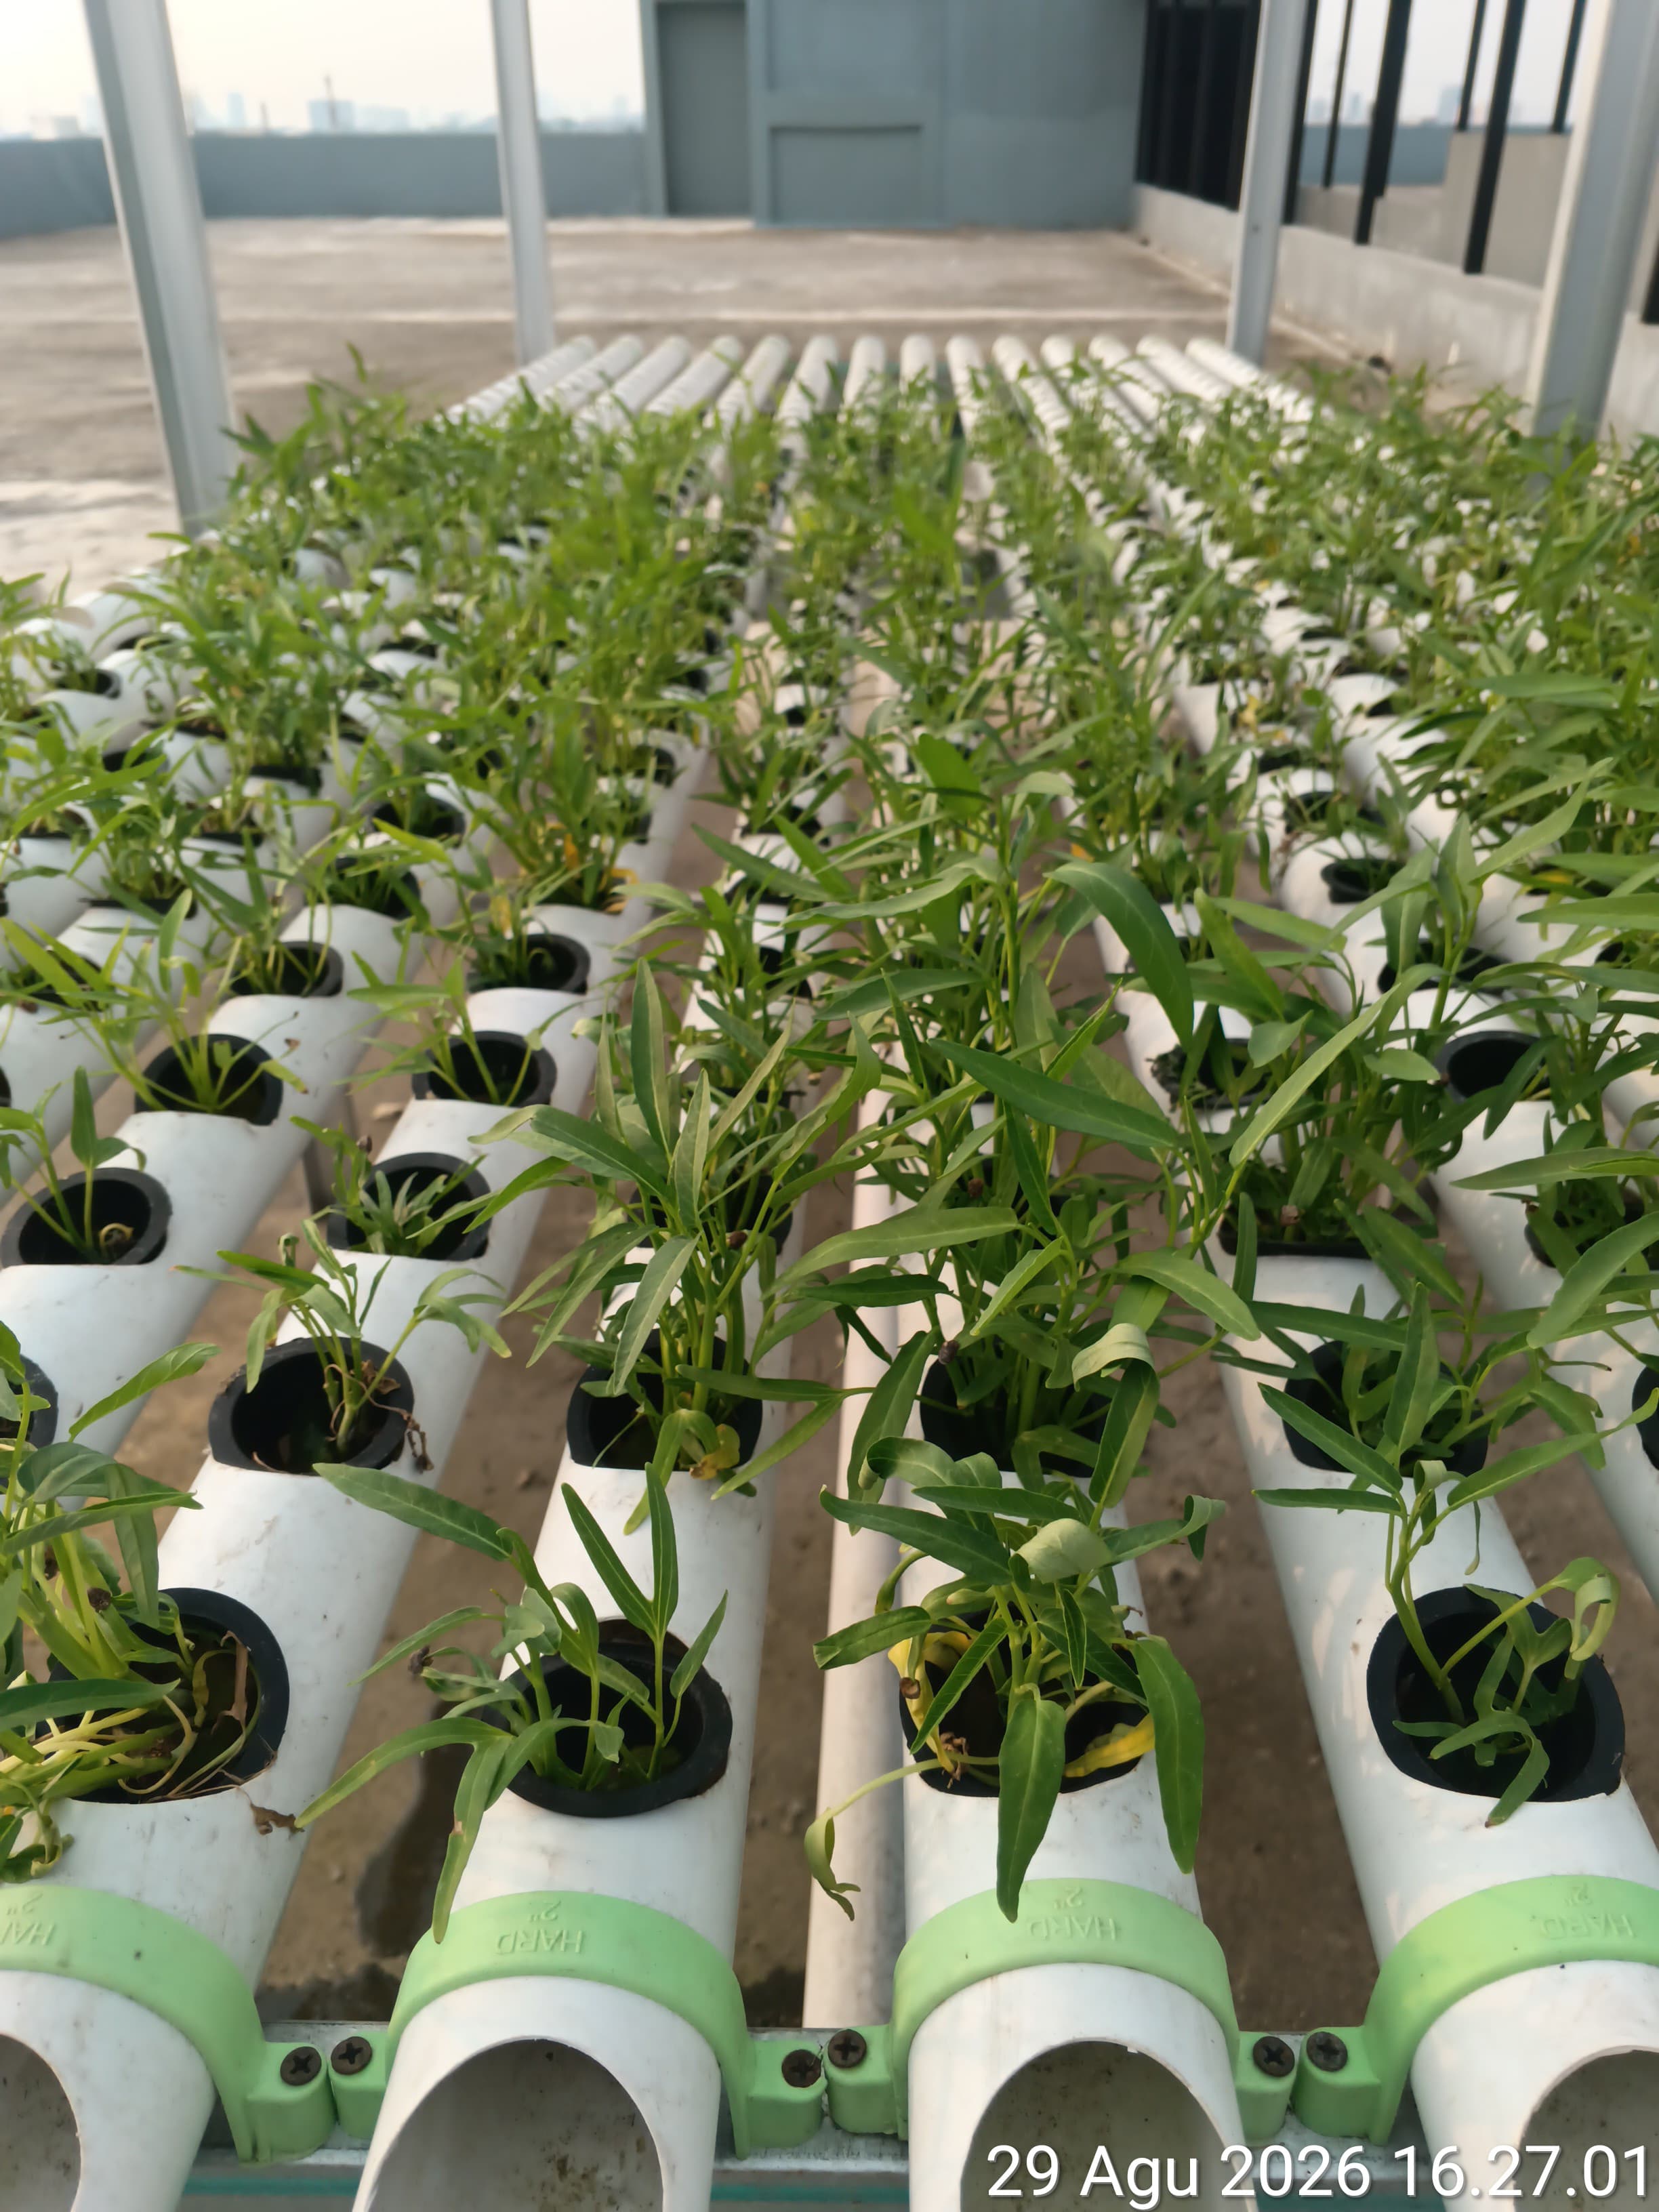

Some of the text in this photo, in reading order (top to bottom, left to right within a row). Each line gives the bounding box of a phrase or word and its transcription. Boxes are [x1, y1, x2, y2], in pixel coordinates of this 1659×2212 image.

[1029, 1916, 1122, 1941] HARD
[1542, 1912, 1637, 1940] HARD
[495, 1929, 586, 1954] HARD
